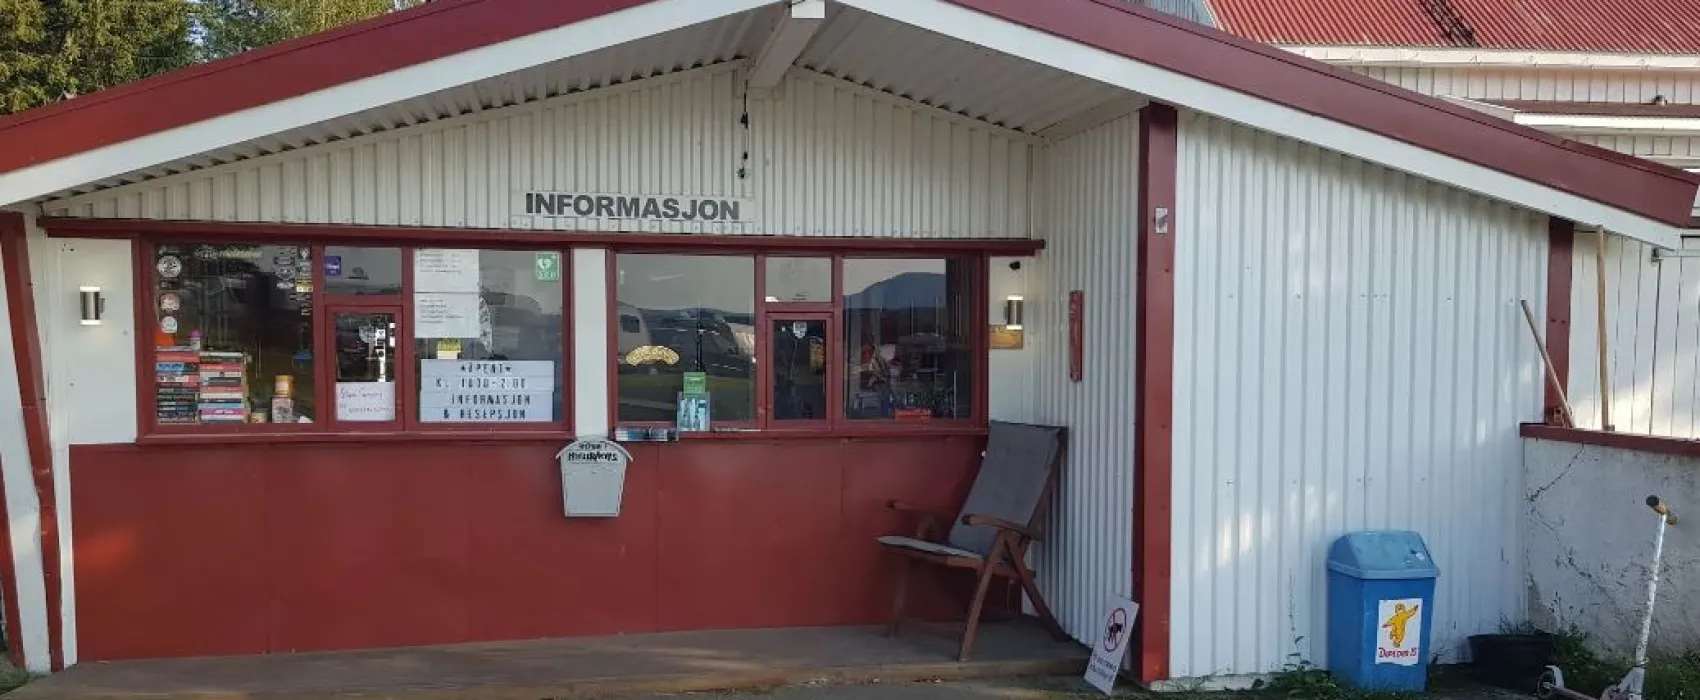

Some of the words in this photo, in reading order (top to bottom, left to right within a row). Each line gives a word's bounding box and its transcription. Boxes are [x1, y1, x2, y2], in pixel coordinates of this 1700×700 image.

[525, 193, 740, 220] INFORMASJON
[452, 394, 530, 405] INFORMASJON
[444, 409, 450, 419] &
[460, 409, 526, 419] RESEPSJON
